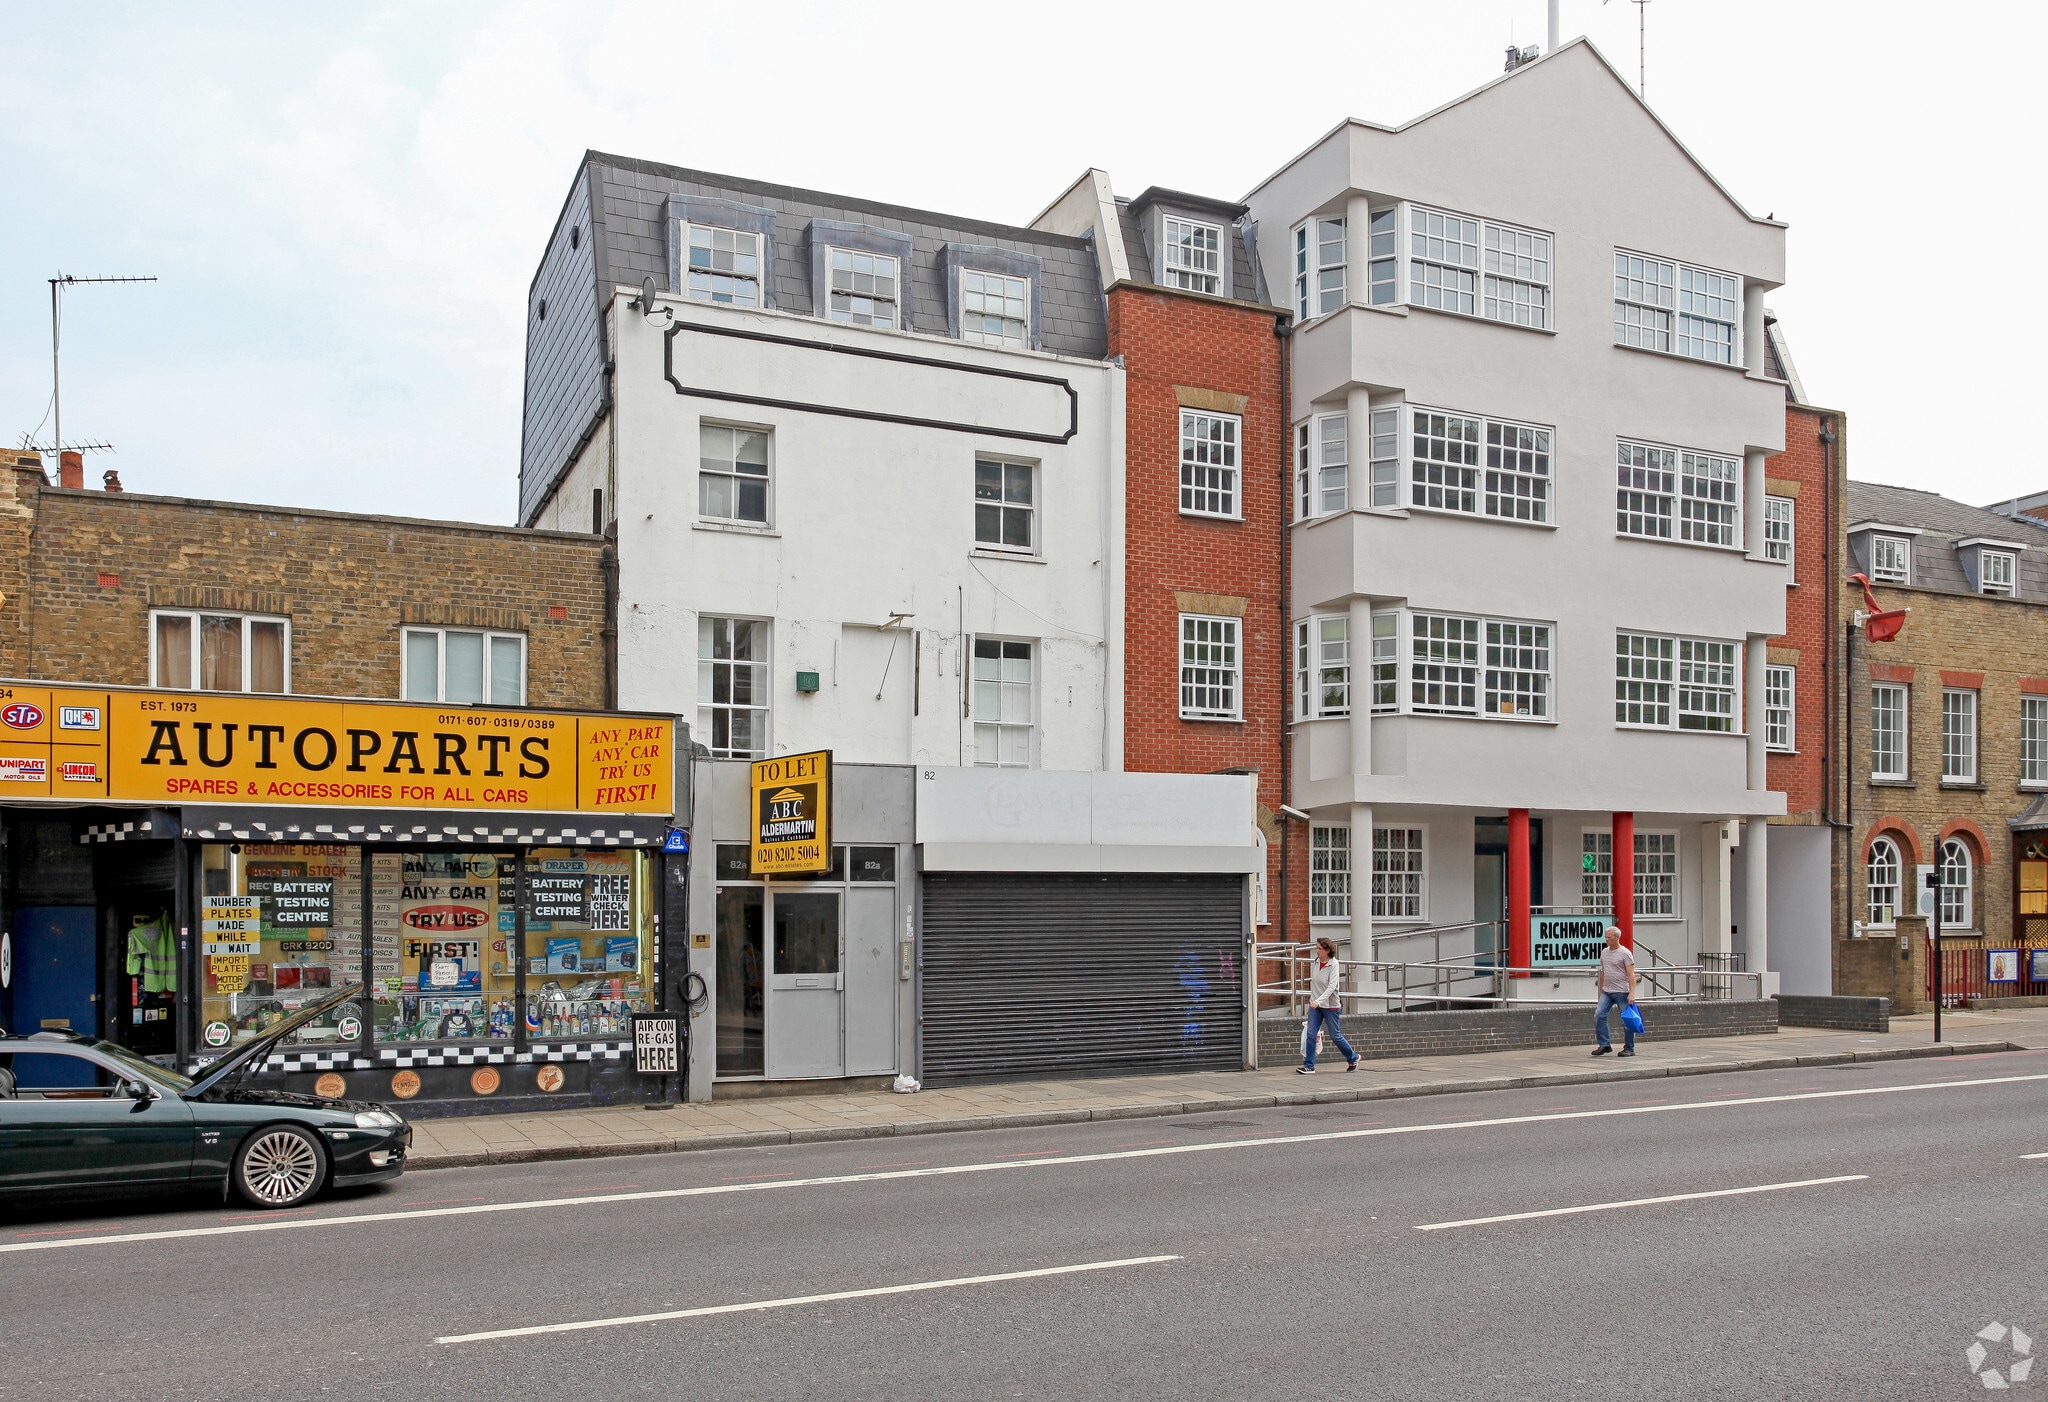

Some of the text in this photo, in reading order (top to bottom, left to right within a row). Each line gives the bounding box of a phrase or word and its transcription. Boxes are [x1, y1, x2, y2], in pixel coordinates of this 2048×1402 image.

[140, 701, 197, 712] EST. 1973
[7, 706, 38, 724] STP
[65, 709, 80, 724] QH
[589, 726, 663, 744] ANY PART
[141, 720, 550, 780] AUTOPARTS
[592, 745, 660, 762] ANY CAR
[0, 759, 45, 769] UNIPART
[758, 757, 818, 782] TO LET
[599, 763, 652, 780] TRY US
[924, 771, 935, 780] 82
[166, 778, 528, 803] SPARES & ACCESSORIES FOR ALL CARS
[595, 783, 657, 805] FIRST!
[771, 800, 802, 819] ABC
[761, 820, 815, 837] ALDERMARTIN
[244, 844, 296, 856] GENUINE
[302, 845, 347, 857] DEALER
[758, 845, 819, 863] 020 8202 5004
[377, 858, 392, 866] KITS
[405, 862, 437, 873] ANY
[444, 862, 481, 873] PART
[545, 861, 585, 869] DRAPER
[591, 861, 630, 872] Tools
[730, 861, 747, 869] 82a
[865, 861, 881, 870] 82a
[308, 865, 347, 877] STOCK
[273, 882, 332, 893] BATTERY
[532, 879, 584, 888] BATTERY
[591, 874, 630, 895] FREE
[401, 886, 440, 900] ANY
[449, 886, 487, 900] CAR
[534, 893, 582, 902] TESTING
[591, 894, 629, 902] WINTER
[210, 898, 252, 907] NUMBER
[276, 897, 330, 908] TESTING
[593, 902, 625, 910] CHECK
[211, 909, 252, 918] PLATES
[277, 911, 329, 922] CENTRE
[535, 907, 581, 916] CENTRE
[217, 920, 245, 930] MADE
[409, 914, 478, 928] TRY US
[591, 910, 630, 930] HERE
[1540, 922, 1604, 940] RICHMOND
[216, 932, 247, 942] WHILE
[210, 943, 252, 954] U WAIT
[282, 941, 333, 950] GRK 920D
[410, 942, 478, 958] FIRST!
[213, 956, 247, 964] IMPORT
[211, 965, 248, 973] PLATES
[217, 975, 244, 983] MOTOR
[217, 984, 244, 992] CYCLE
[638, 1020, 674, 1032] AIR CON
[638, 1033, 675, 1045] RE-GAS
[638, 1047, 675, 1071] HERE
